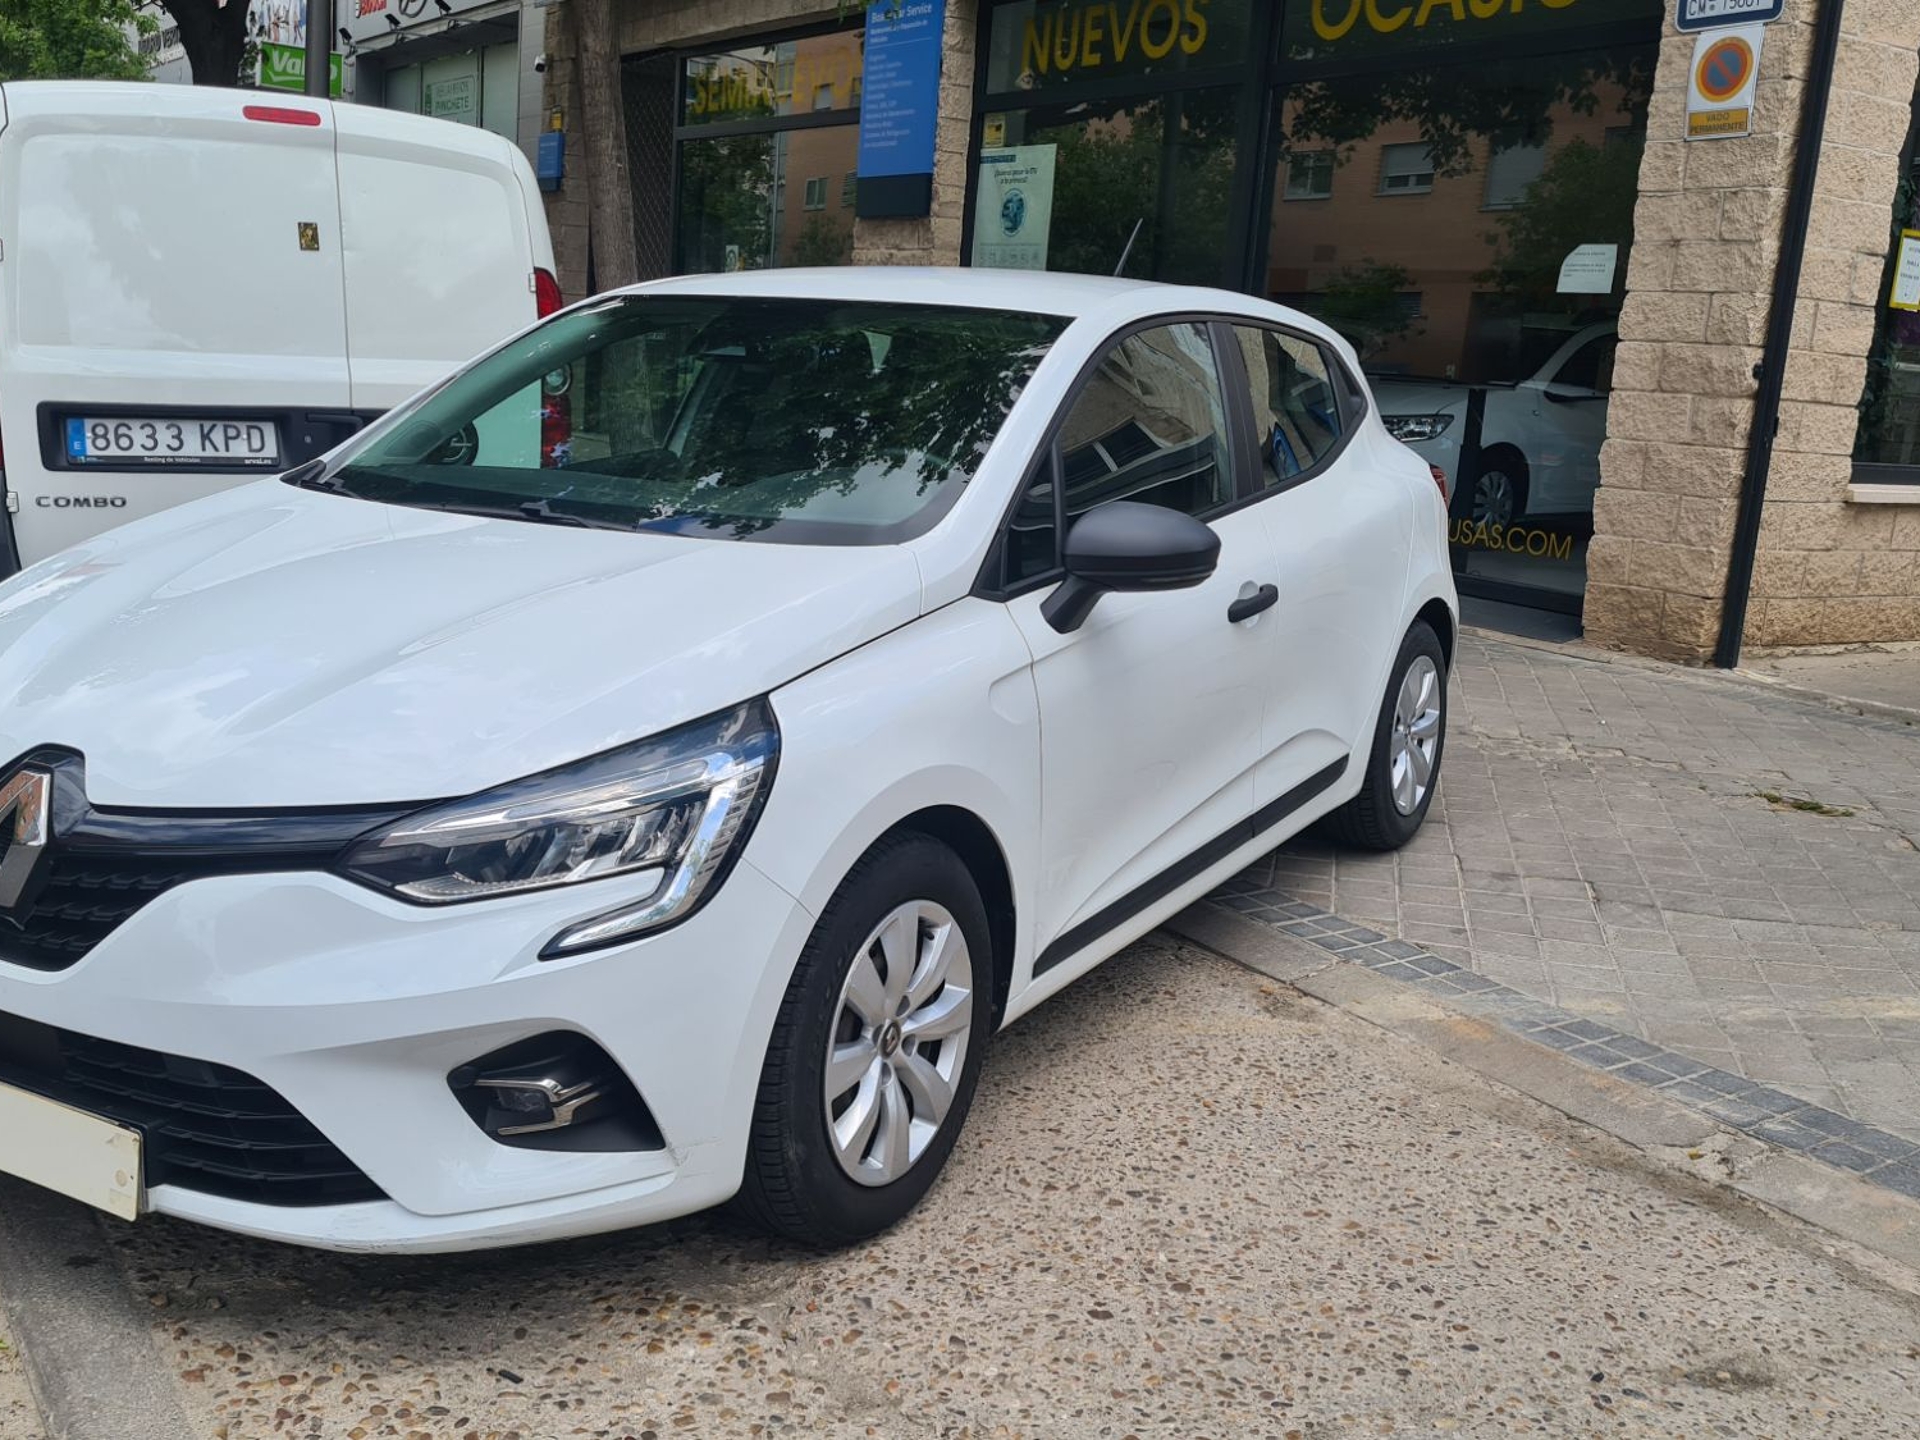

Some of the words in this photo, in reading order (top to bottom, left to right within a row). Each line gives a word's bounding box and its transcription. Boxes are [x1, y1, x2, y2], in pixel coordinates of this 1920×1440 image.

[1020, 0, 1208, 75] NUEVOS
[272, 50, 339, 80] Valo
[74, 441, 81, 450] E
[90, 423, 185, 452] 8633
[199, 423, 266, 453] KPD
[36, 496, 127, 508] COMBO
[1448, 518, 1572, 560] USAS.COM
